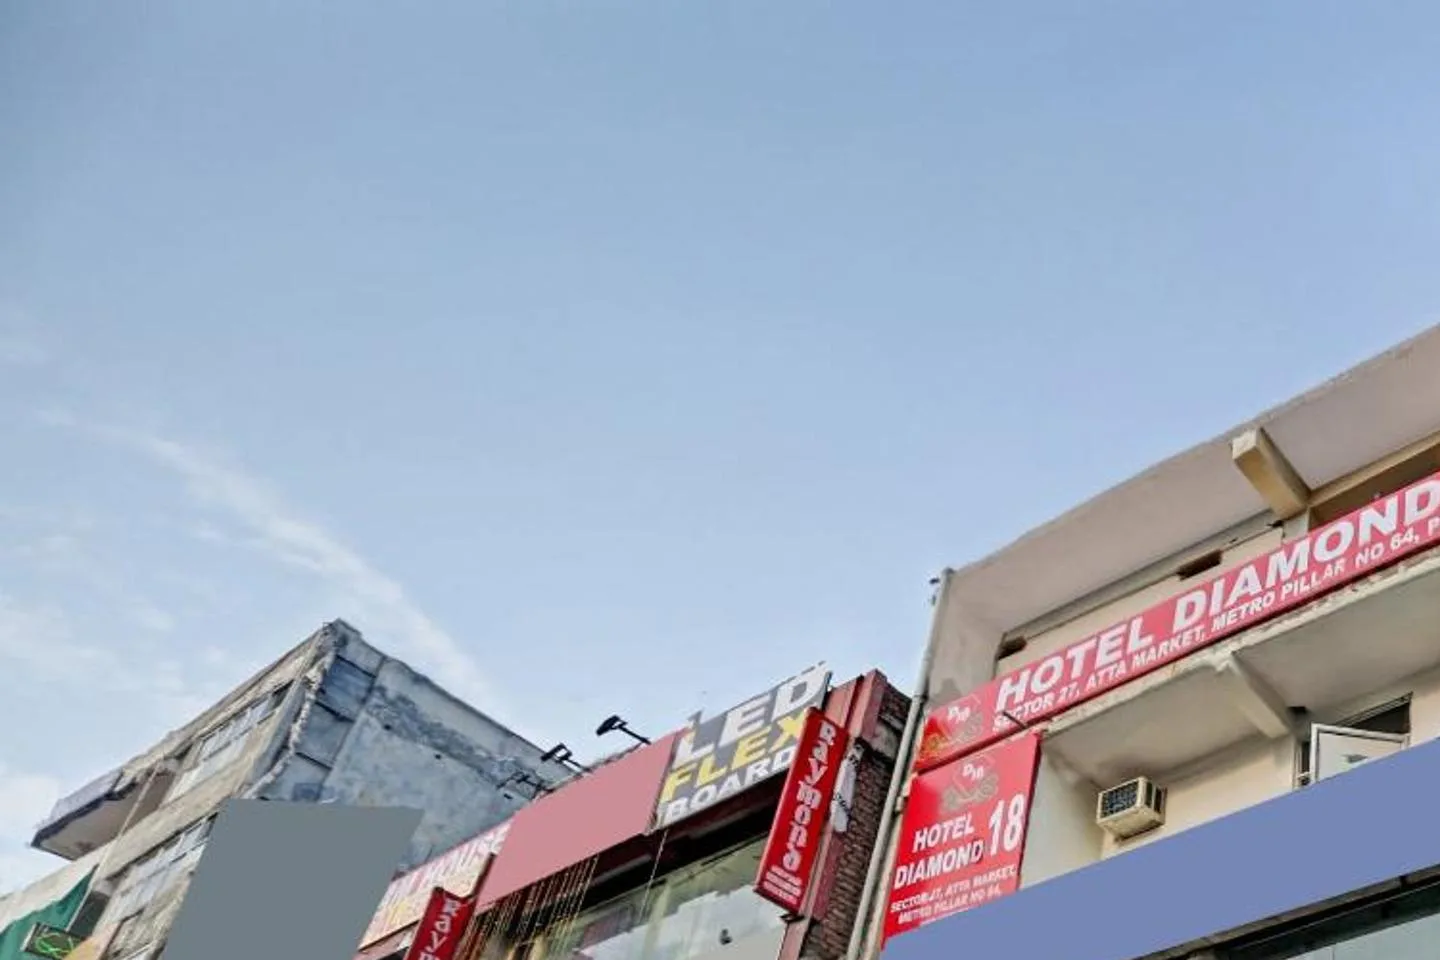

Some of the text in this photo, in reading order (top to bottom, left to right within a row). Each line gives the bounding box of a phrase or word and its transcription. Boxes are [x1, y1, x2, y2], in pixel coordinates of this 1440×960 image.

[1086, 663, 1126, 692] ATTA
[1131, 629, 1205, 670] MARKET,
[1211, 590, 1275, 631] METRO
[1280, 557, 1346, 602] PILLAR
[1355, 543, 1384, 568] NO
[995, 616, 1154, 713] HOTEL
[661, 710, 806, 802] FLEX
[673, 664, 827, 768] LED
[665, 746, 795, 825] BOARD
[782, 719, 837, 870] Raymond
[988, 794, 1025, 857] 18
[894, 839, 985, 889] DIAMOND
[912, 812, 975, 852] HOTEL
